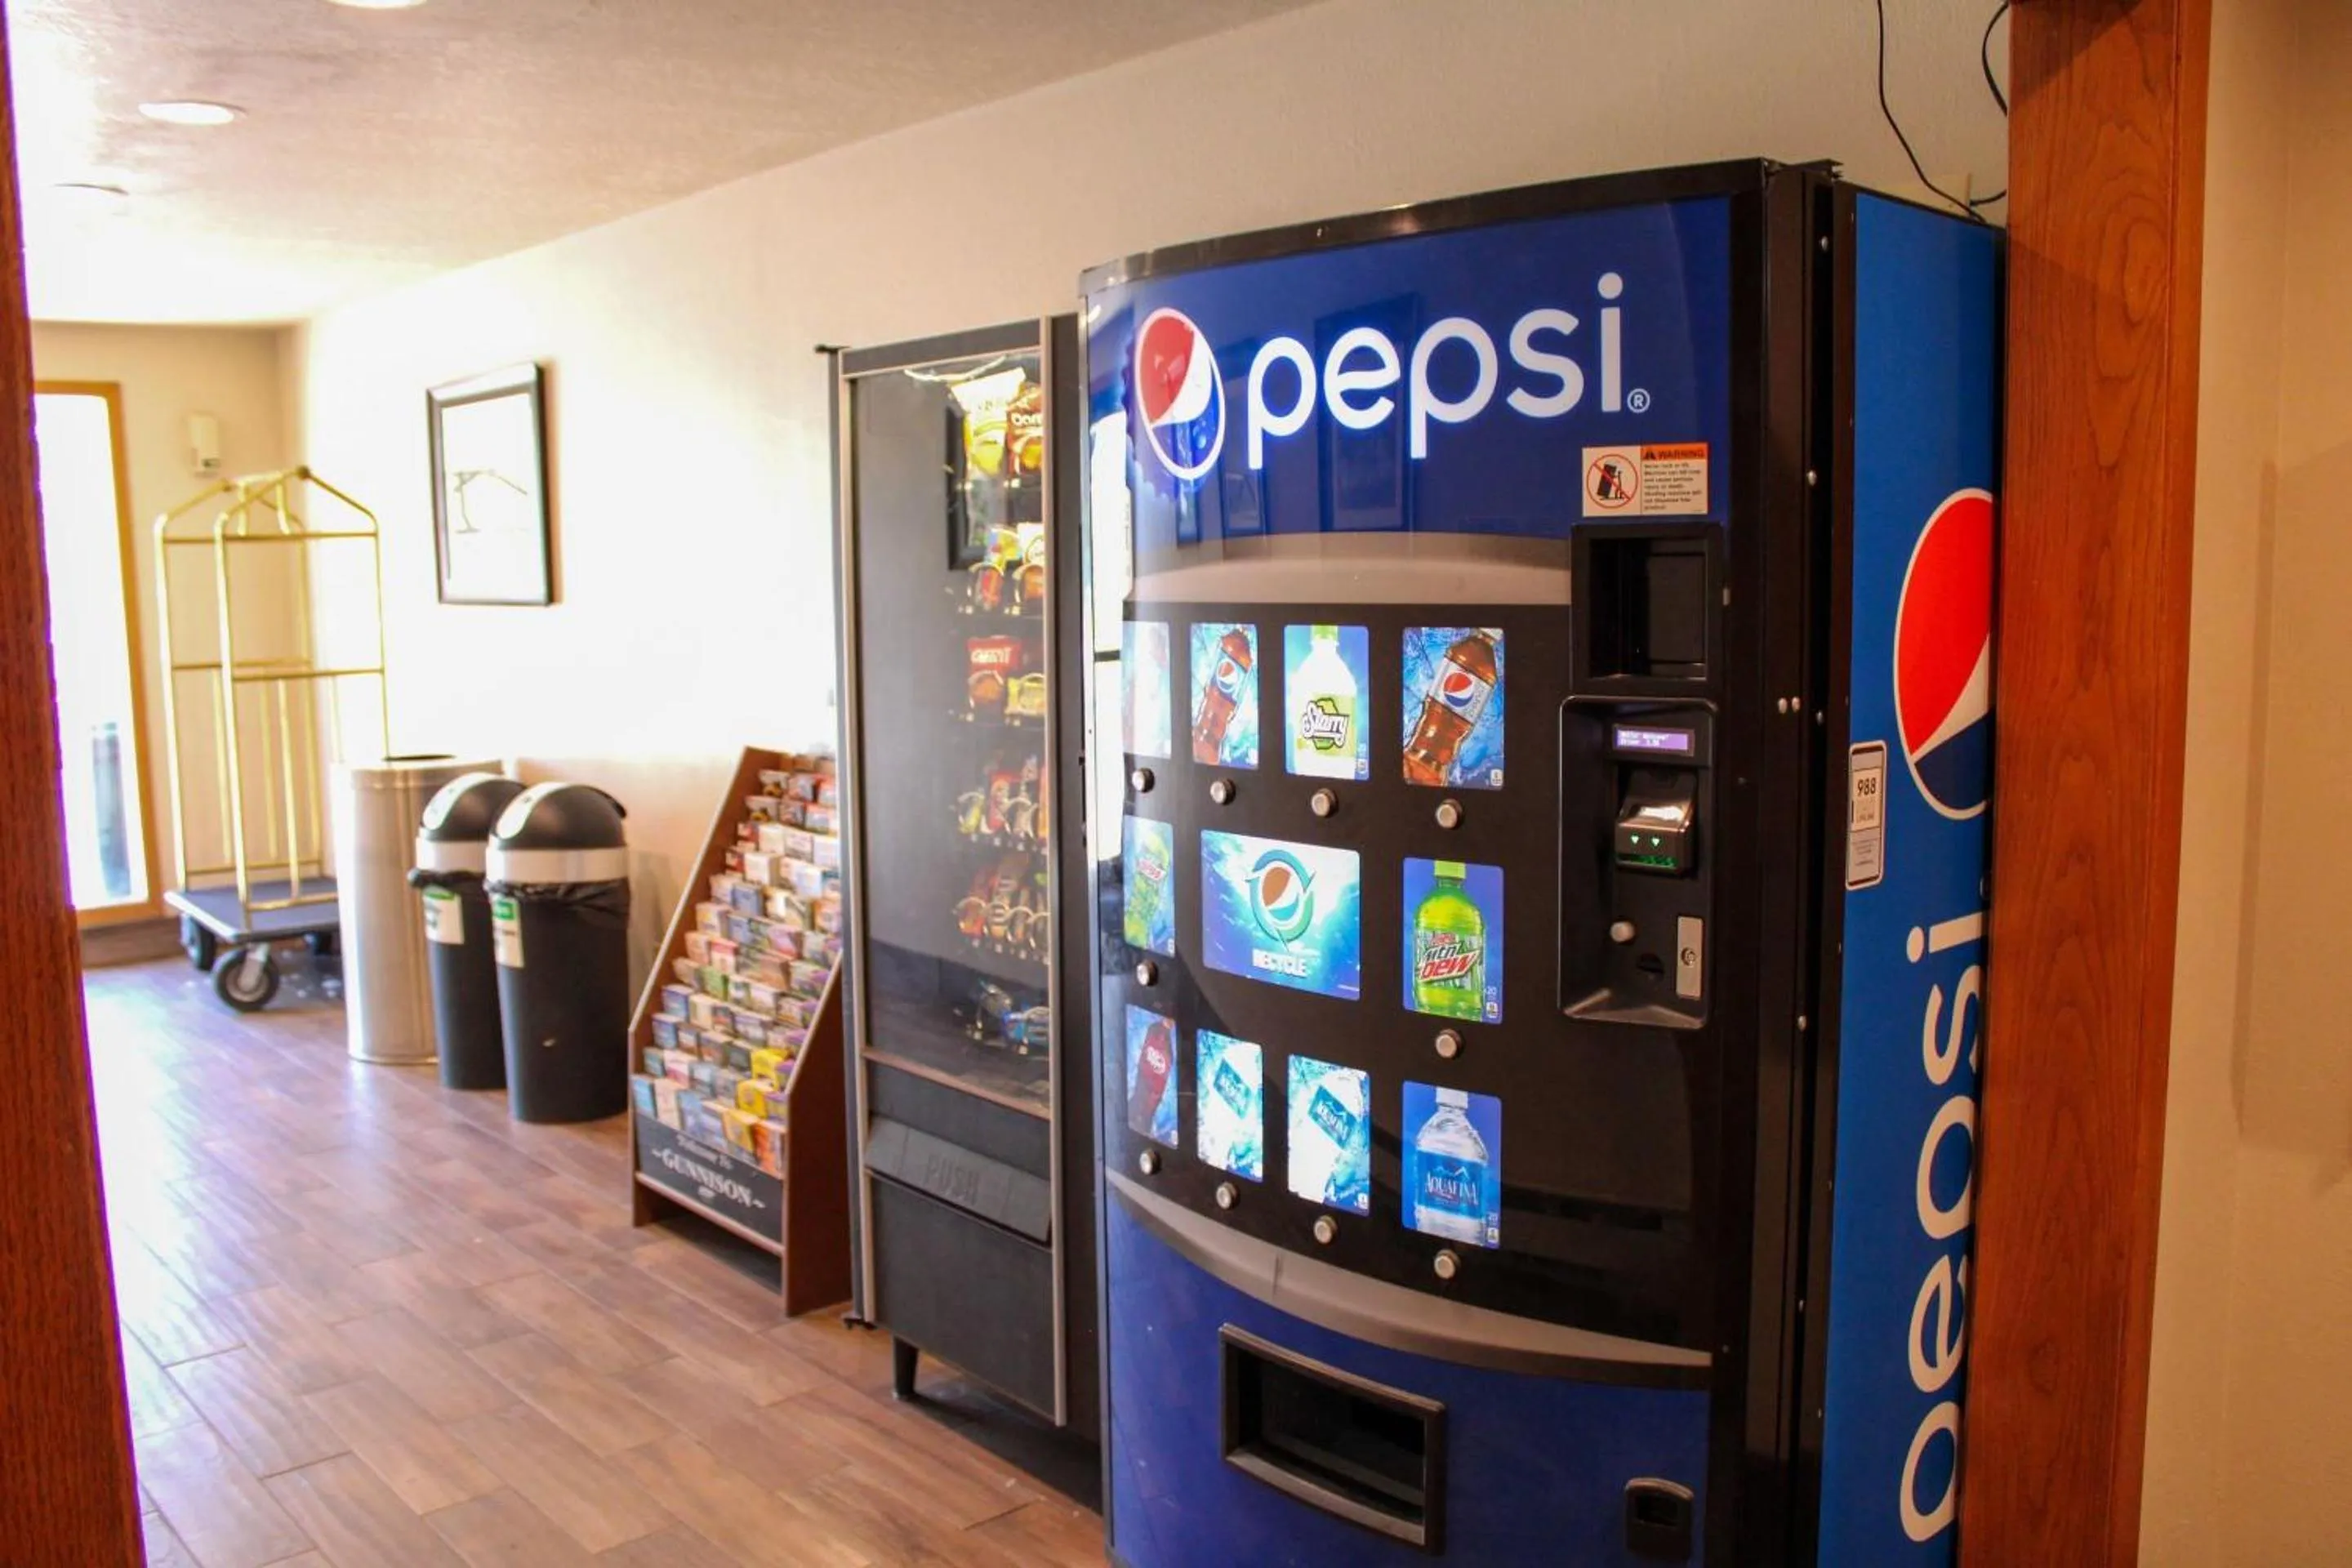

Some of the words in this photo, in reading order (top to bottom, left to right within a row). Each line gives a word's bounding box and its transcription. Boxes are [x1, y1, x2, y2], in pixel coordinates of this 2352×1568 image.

[1248, 272, 1624, 470] pepsi
[1858, 777, 1876, 796] 988
[662, 1148, 753, 1208] GUNNISON
[922, 1152, 980, 1206] PUSH
[1425, 1171, 1479, 1206] AQUAFINA
